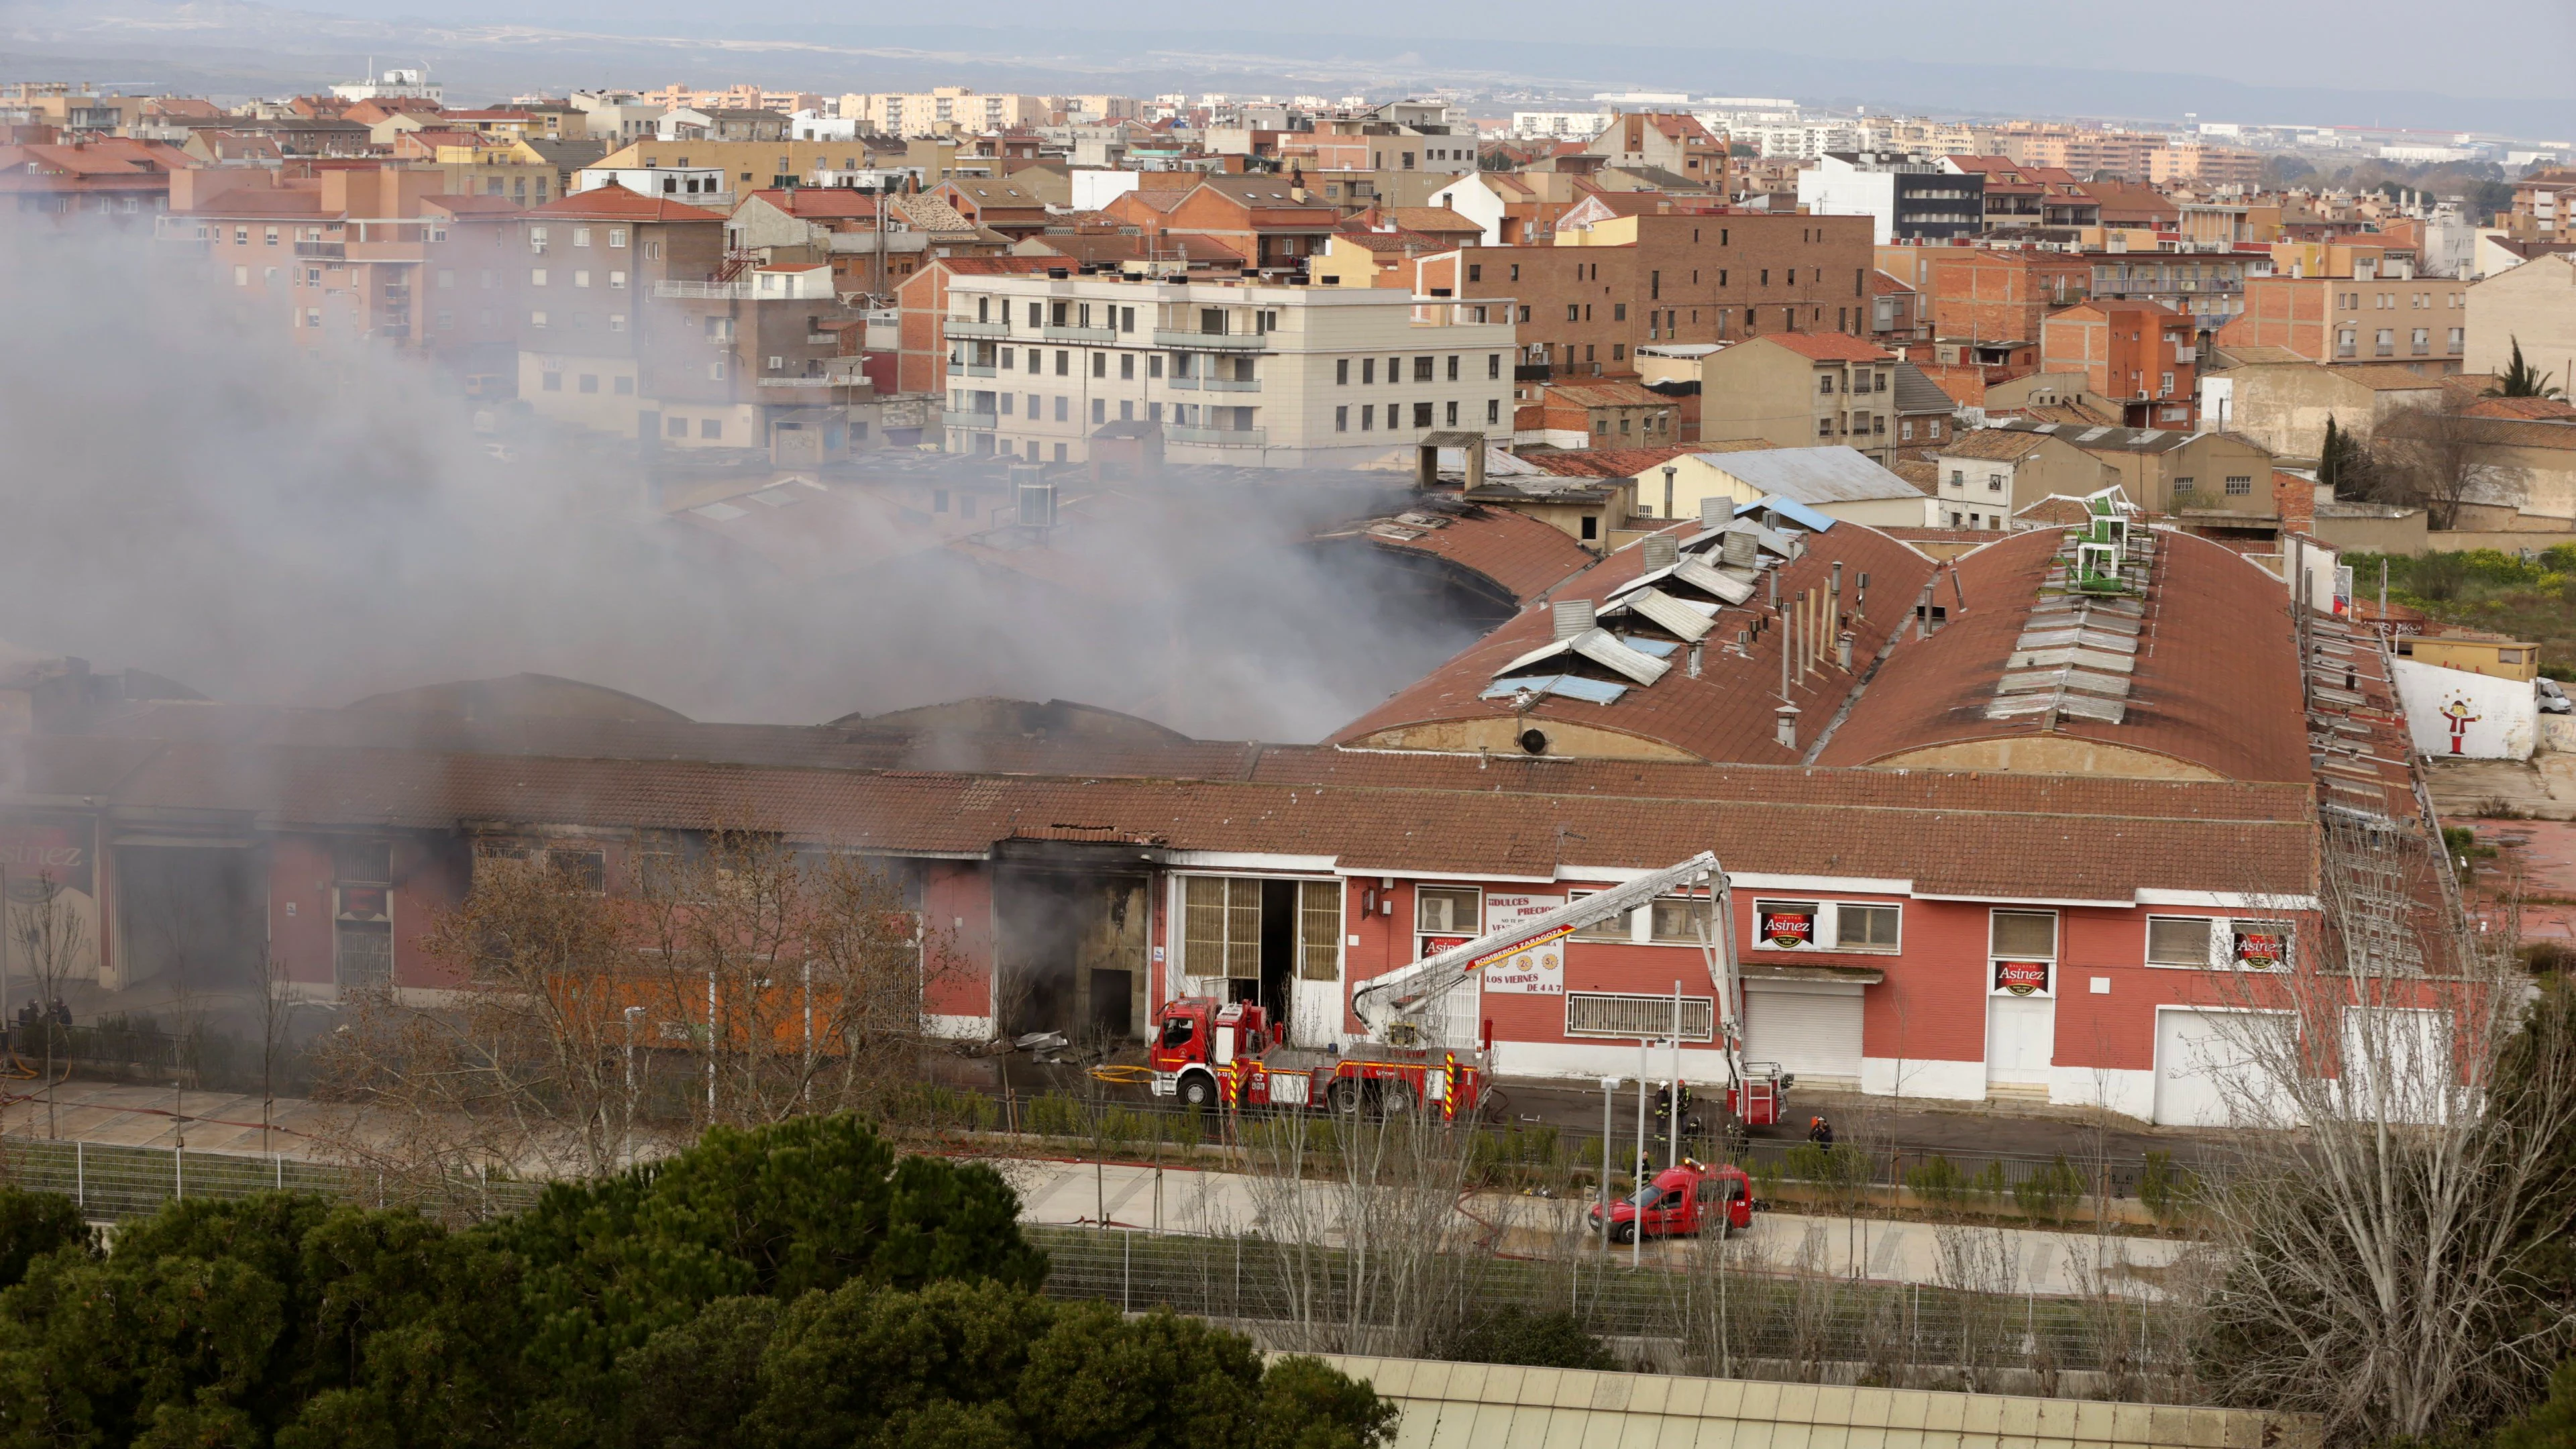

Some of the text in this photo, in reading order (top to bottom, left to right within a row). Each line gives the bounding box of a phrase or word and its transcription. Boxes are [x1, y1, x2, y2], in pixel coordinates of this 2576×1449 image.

[0, 839, 82, 866] sinez
[1764, 918, 1810, 932] Asinez
[1425, 941, 1456, 953] Asin
[1474, 928, 1564, 966] BOMBEROS ZARAGOZA
[1486, 974, 1538, 983] LOS VIERNES
[1998, 967, 2045, 980] Asinez
[1527, 983, 1538, 991] DE
